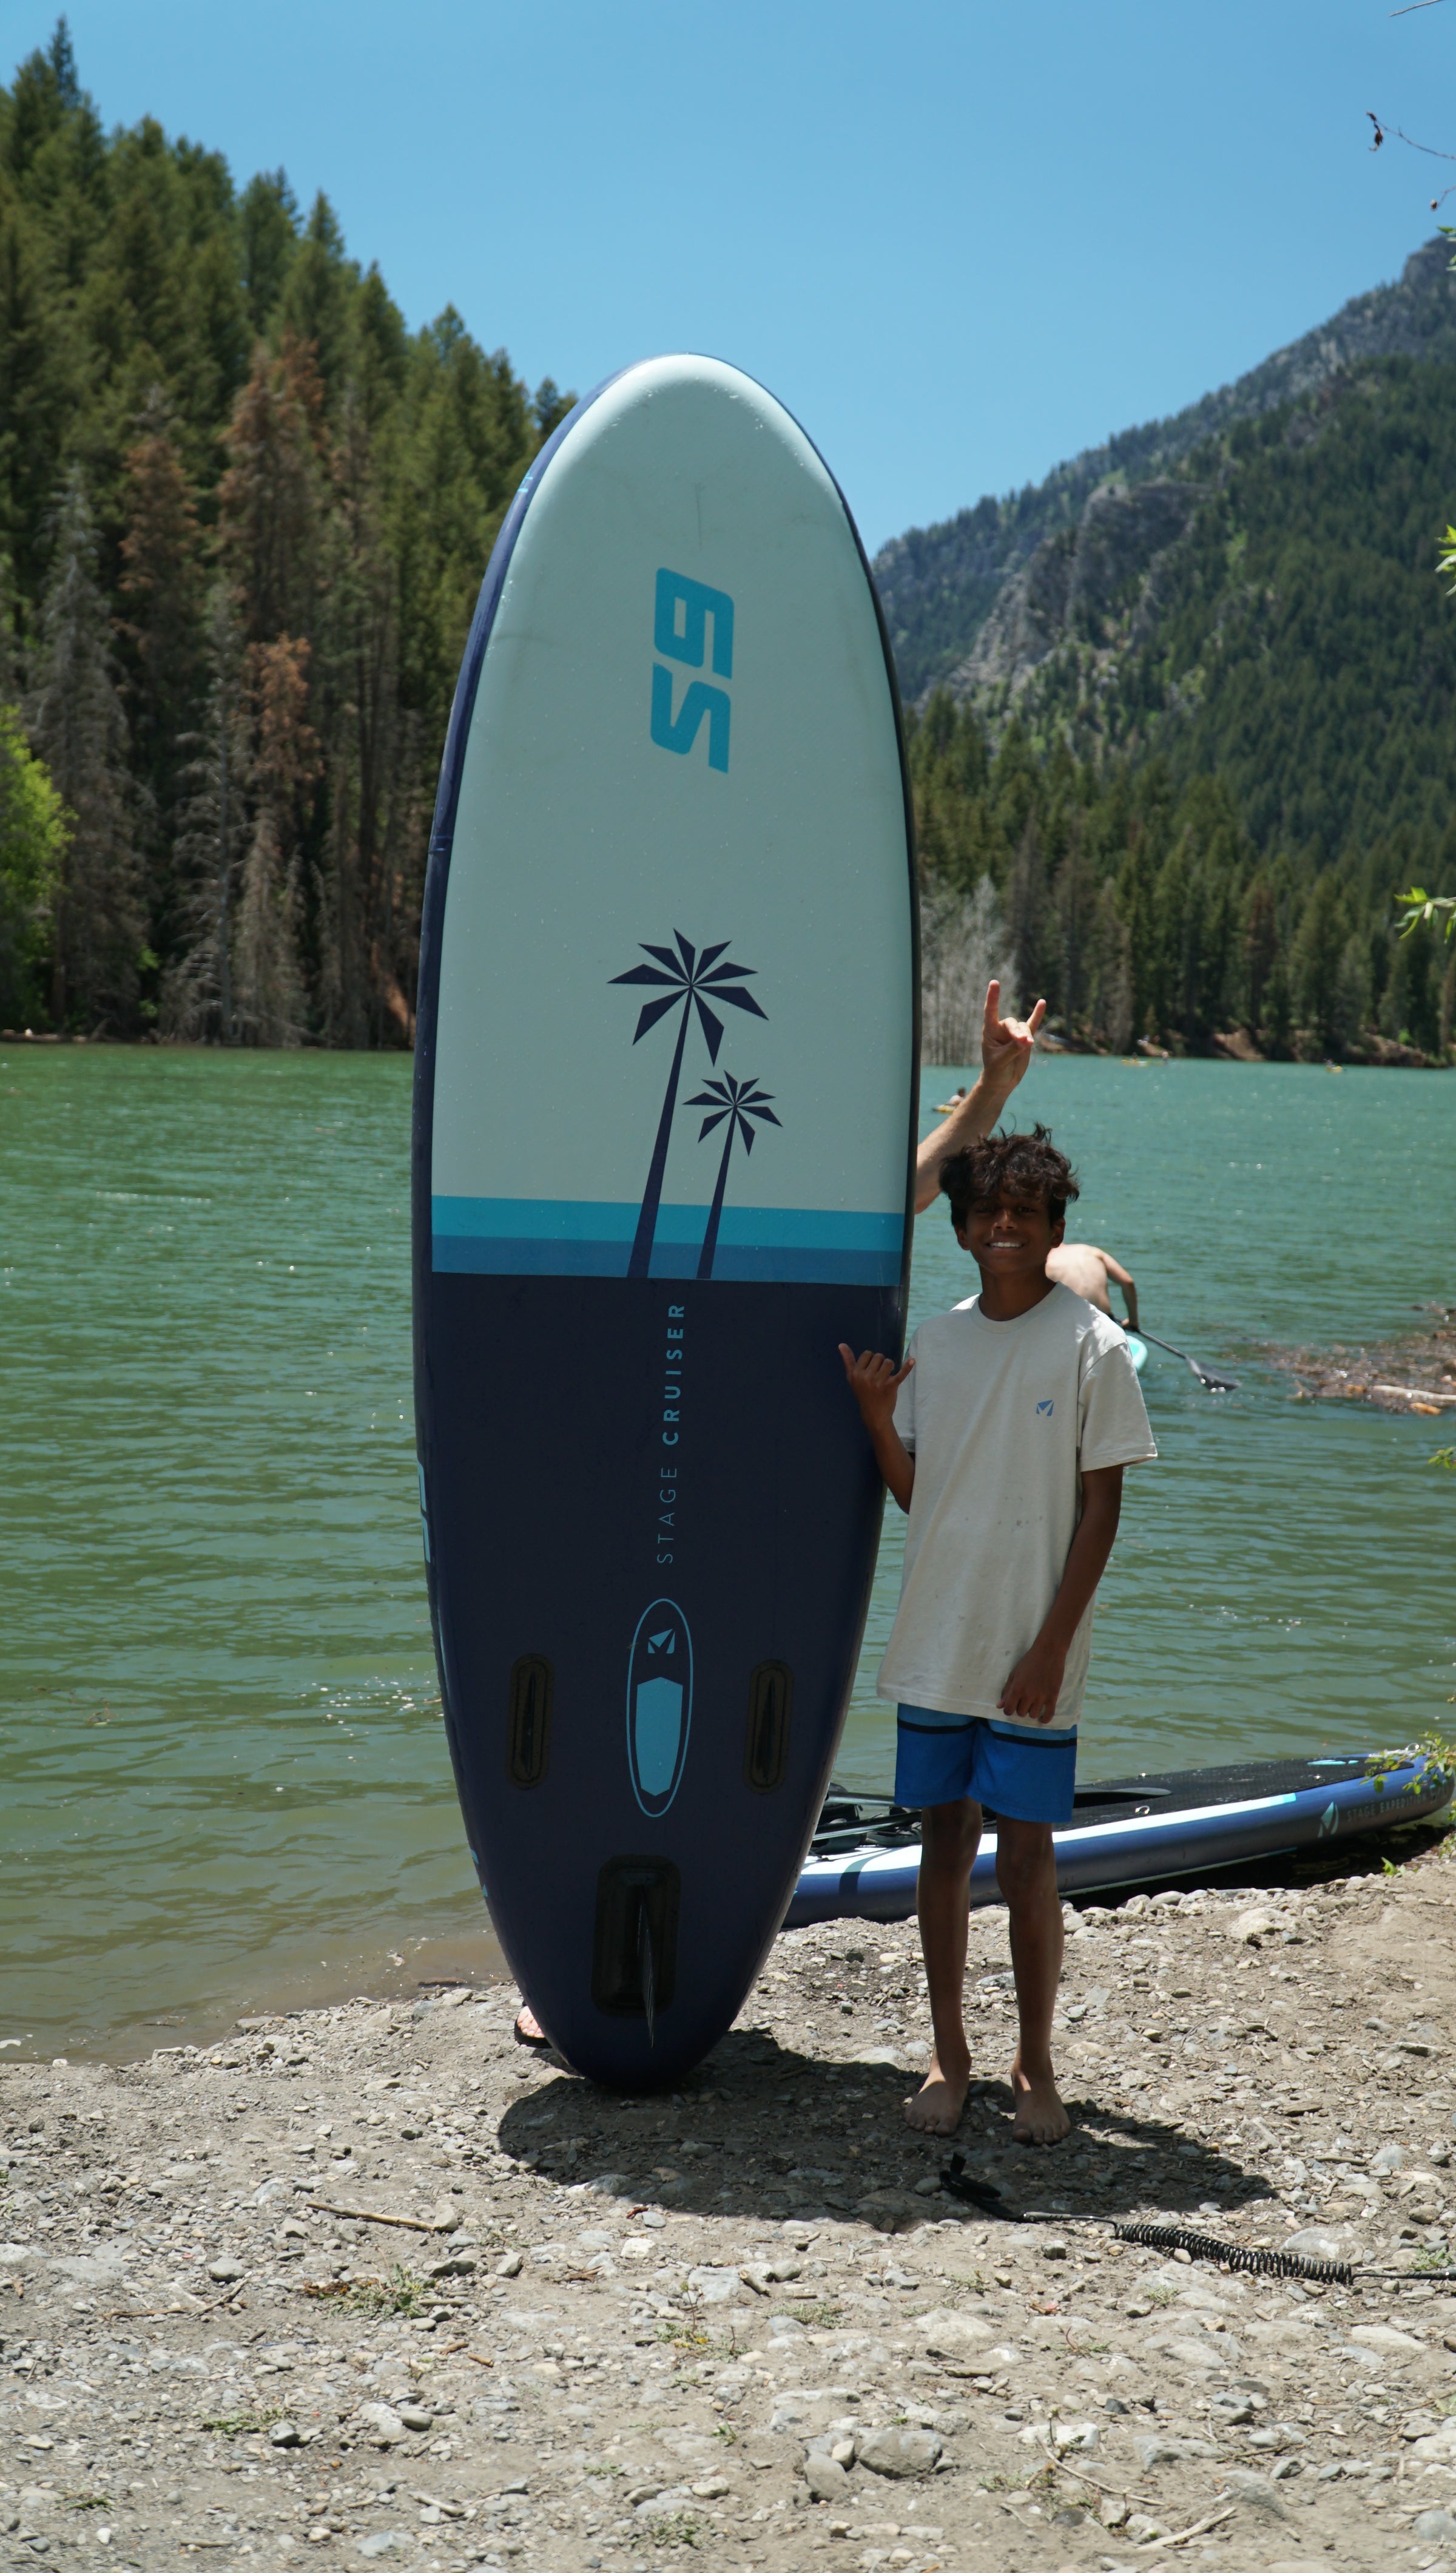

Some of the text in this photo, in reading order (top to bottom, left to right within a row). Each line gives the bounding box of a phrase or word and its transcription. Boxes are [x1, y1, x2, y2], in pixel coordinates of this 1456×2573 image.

[650, 567, 735, 774] S9
[657, 1305, 685, 1564] STAGE CRUISER
[1346, 1804, 1376, 1821] STAGE
